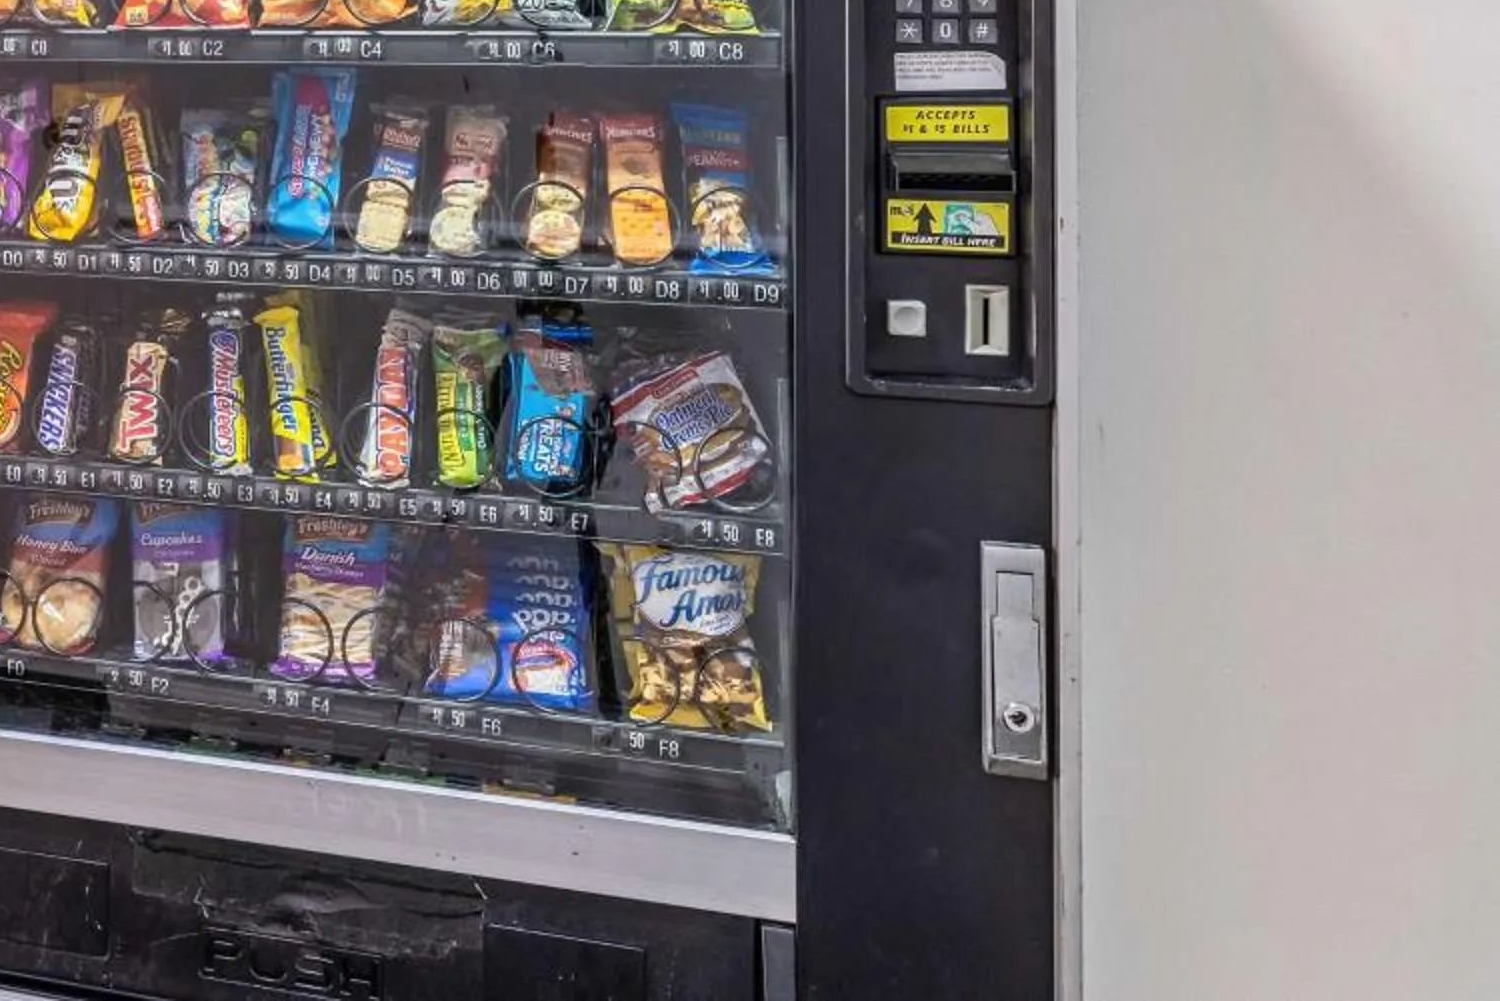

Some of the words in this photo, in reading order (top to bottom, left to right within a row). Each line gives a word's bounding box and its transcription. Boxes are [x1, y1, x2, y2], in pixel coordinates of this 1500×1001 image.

[940, 23, 951, 39] 0
[976, 23, 989, 39] #
[31, 39, 48, 57] C0
[203, 40, 223, 57] C2
[361, 40, 383, 59] C4
[719, 41, 744, 60] C8
[915, 110, 976, 120] ACCEPTS
[952, 124, 990, 134] BILLS
[900, 234, 941, 245] INSERT
[942, 235, 965, 246] BILL
[966, 237, 997, 247] HERE
[2, 250, 24, 266] D0
[77, 254, 98, 271] D1
[153, 257, 173, 275] D2
[227, 261, 250, 278] D3
[308, 265, 331, 282] D4
[391, 268, 415, 286] D5
[476, 272, 501, 291] D6
[564, 276, 589, 294] D7
[655, 280, 679, 299] D8
[754, 283, 780, 302] D9
[264, 325, 299, 434] Butterfinger
[38, 344, 77, 449] SNICKERS
[211, 349, 238, 457] Musketeers
[655, 390, 719, 431] Oatmeal
[534, 421, 556, 473] TREATS
[6, 464, 21, 482] E0
[81, 471, 96, 488] E1
[157, 478, 173, 495] E2
[237, 484, 253, 502] E3
[315, 491, 332, 509] E4
[400, 498, 417, 516] E5
[480, 506, 497, 523] E6
[571, 512, 589, 531] E7
[16, 534, 58, 554] Honey
[139, 532, 203, 549] Cupcakes
[755, 528, 775, 547] E8
[301, 545, 356, 566] Danish
[7, 660, 24, 676] F0
[151, 679, 169, 695] F2
[311, 697, 330, 716] F4
[481, 718, 501, 737] F6
[659, 739, 680, 758] F8
[198, 929, 385, 1000] PUSH
